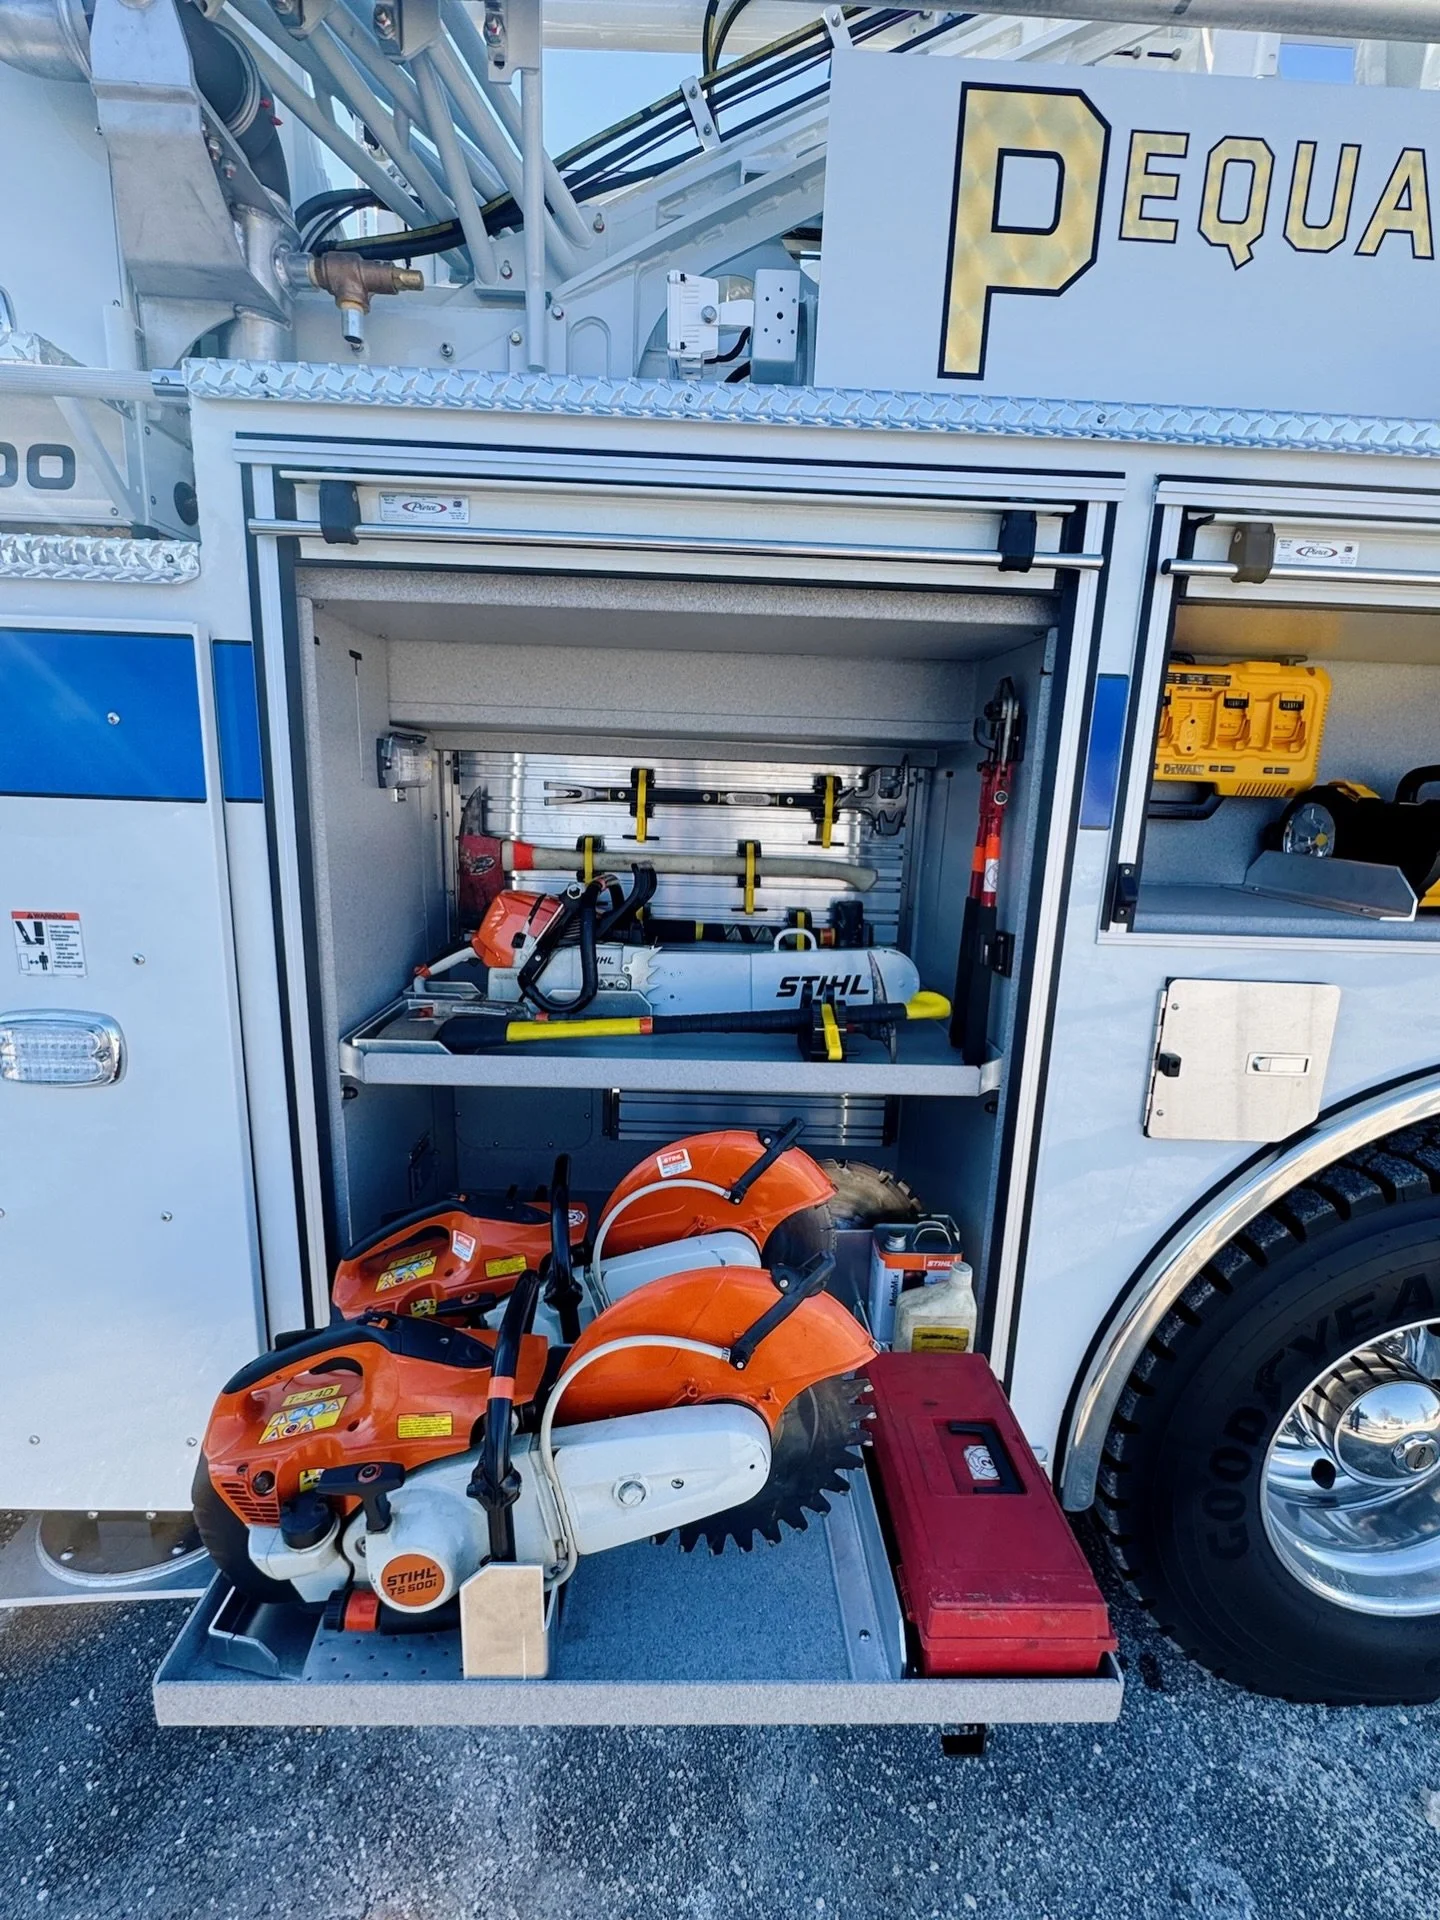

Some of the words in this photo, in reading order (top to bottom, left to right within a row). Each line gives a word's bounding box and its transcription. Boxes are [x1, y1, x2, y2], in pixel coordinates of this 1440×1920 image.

[938, 81, 1435, 381] PEQUA
[411, 501, 437, 513] Pierce
[1304, 546, 1328, 557] Pierce
[596, 956, 614, 965] IHL
[776, 974, 870, 997] STIHL
[386, 1567, 437, 1587] STIHL
[389, 1585, 405, 1596] TS
[407, 1578, 437, 1593] 500i
